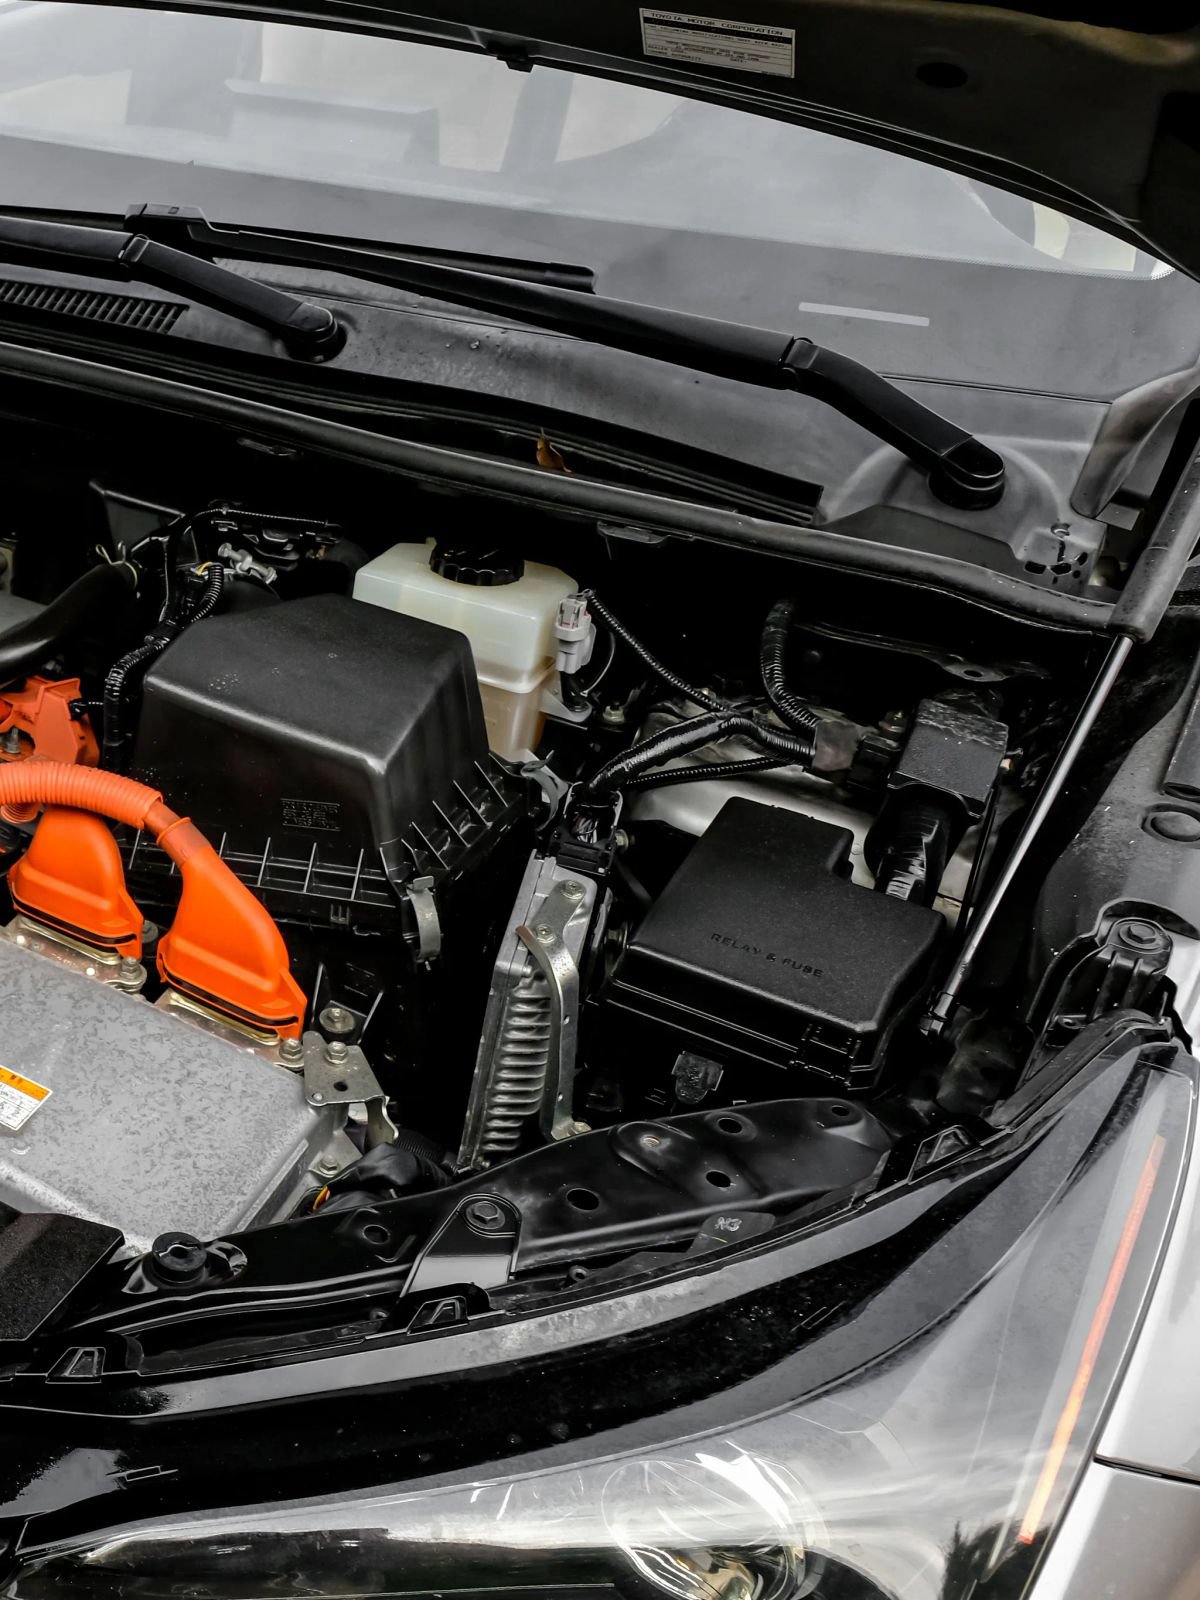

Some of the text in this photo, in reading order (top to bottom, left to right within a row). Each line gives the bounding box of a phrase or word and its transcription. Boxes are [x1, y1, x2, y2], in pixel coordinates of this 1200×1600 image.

[652, 12, 784, 36] TOYOTA MOTOR CORPORATION
[710, 933, 762, 954] RELAY
[782, 958, 823, 978] FUSE
